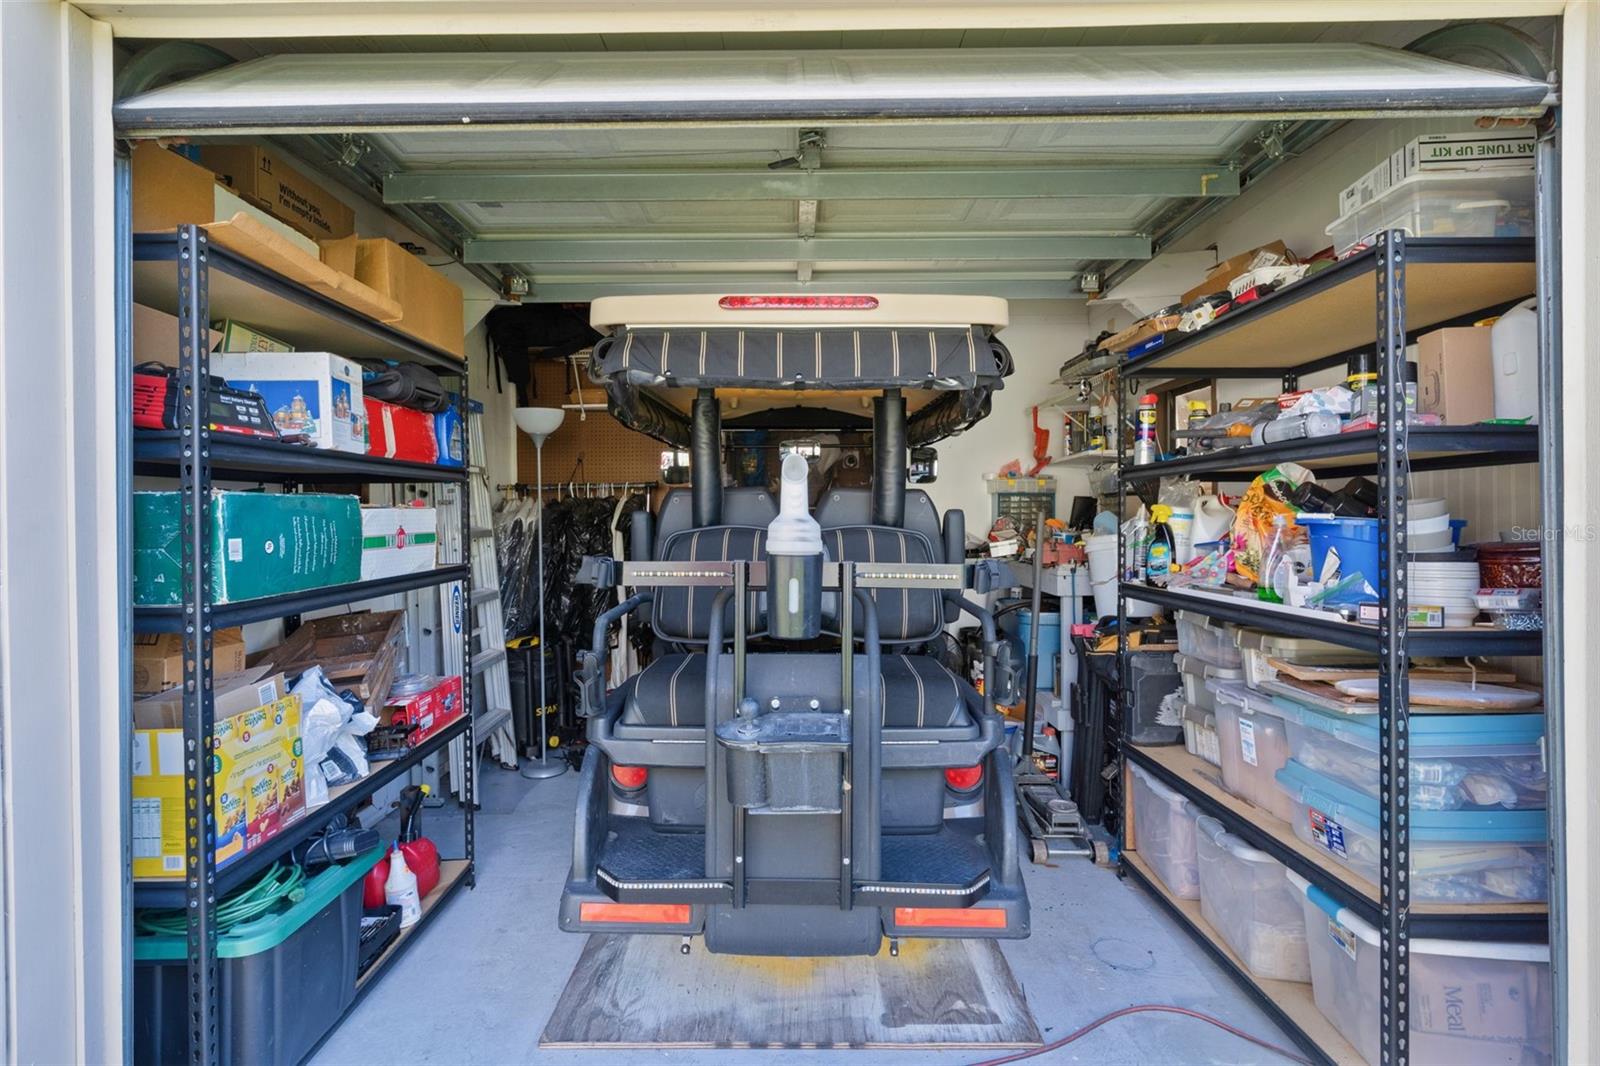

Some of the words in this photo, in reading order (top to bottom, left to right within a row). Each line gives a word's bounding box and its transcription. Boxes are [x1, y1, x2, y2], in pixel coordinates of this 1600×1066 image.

[1431, 146, 1452, 158] KIT
[1455, 145, 1475, 156] UP
[1477, 144, 1515, 156] TUNE
[1443, 985, 1467, 1031] Meal
